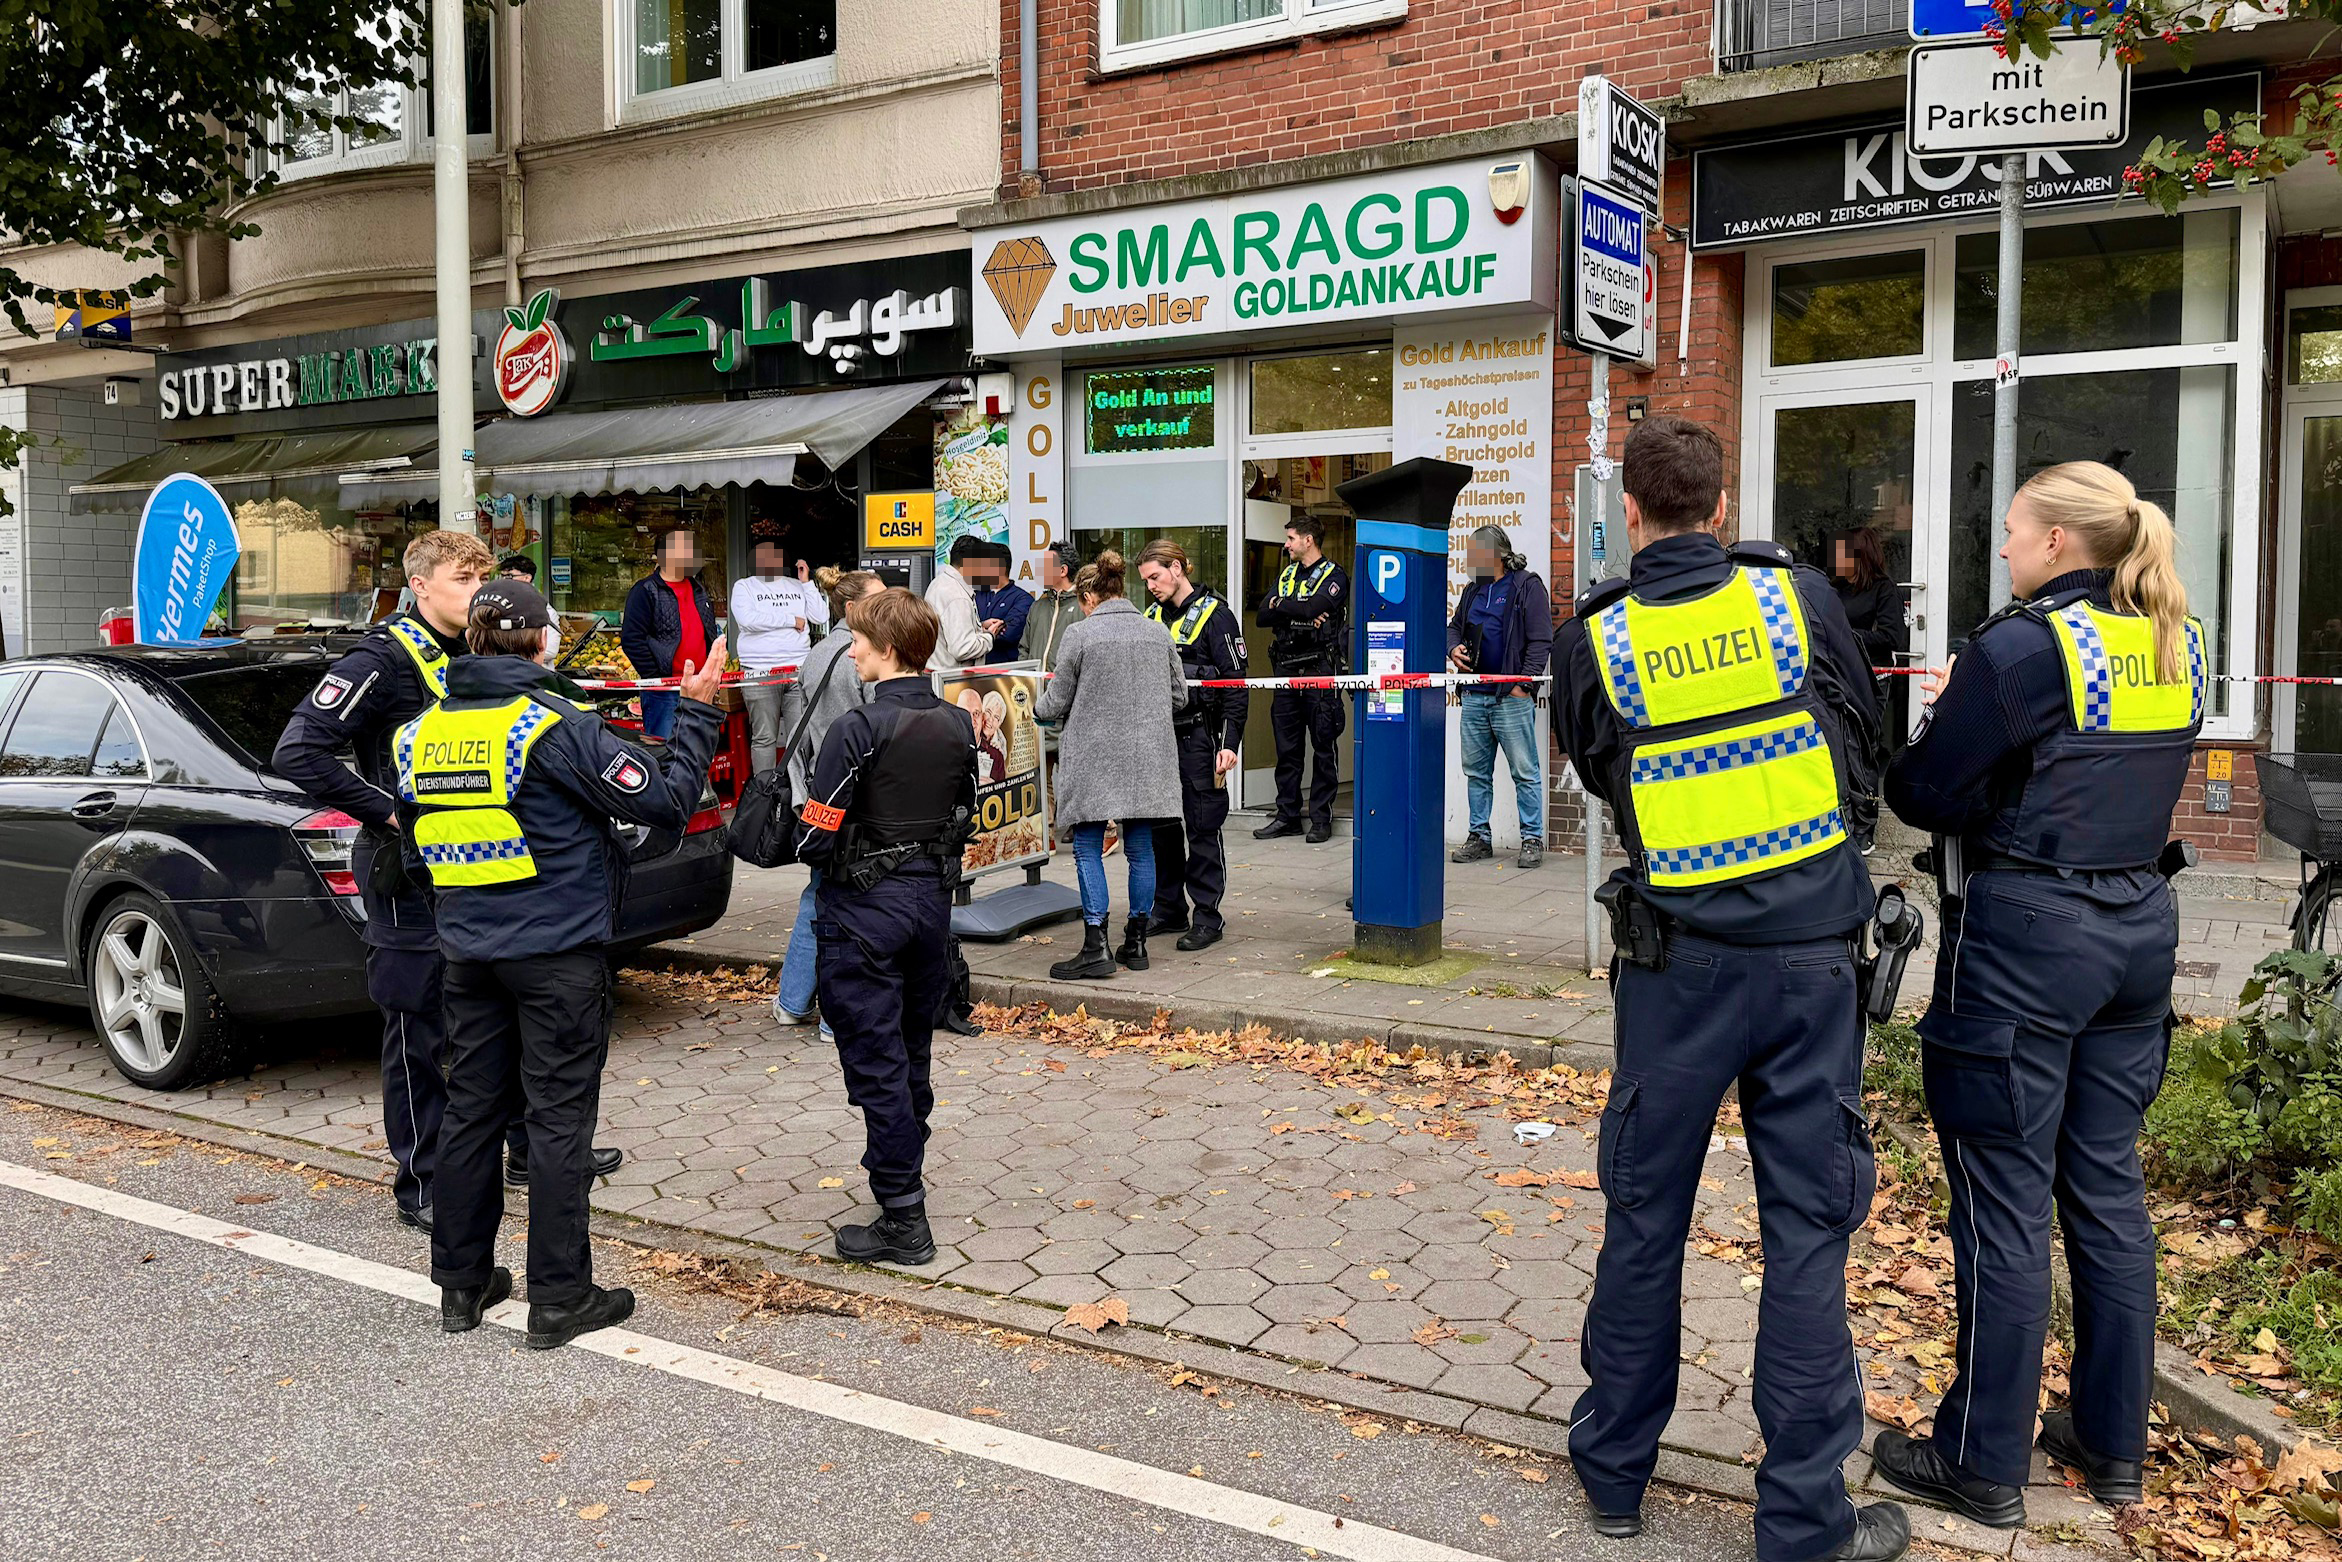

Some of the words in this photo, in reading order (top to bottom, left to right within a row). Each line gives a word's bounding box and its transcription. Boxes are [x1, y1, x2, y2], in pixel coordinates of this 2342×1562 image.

[1992, 63, 2043, 91] mit
[1928, 95, 2107, 131] Parkschein
[1612, 100, 1658, 172] KIOSK
[1583, 203, 1640, 256] AUTOMAT
[1724, 211, 1821, 235] TABAKWAREN
[1829, 198, 1929, 223] ZEITSCHRIFTEN
[1069, 185, 1469, 293] SMARAGD
[1233, 253, 1497, 319] GOLDANKAUF
[1582, 252, 1640, 293] Parkschein
[1052, 293, 1208, 336] Juwelier
[1585, 283, 1605, 312] hier
[1609, 290, 1636, 320] lösen
[1400, 341, 1454, 366] Gold
[1459, 332, 1547, 361] Ankauf
[106, 386, 116, 400] 74
[1402, 379, 1417, 390] zu
[1420, 369, 1540, 390] Tageshöchstpreisen
[1095, 389, 1137, 410] Gold
[1142, 388, 1168, 407] An
[1174, 385, 1212, 405] und
[1445, 397, 1510, 420] Altgold
[1114, 416, 1191, 439] verkauf
[1446, 419, 1528, 441] Zahngold
[945, 431, 988, 457] Hoşgeldiniz
[1446, 441, 1536, 463] Bruchgold
[880, 521, 922, 538] CASH
[156, 500, 204, 641] Hermes
[192, 538, 217, 609] PaketShop
[1379, 555, 1401, 593] P
[757, 593, 801, 602] BALMAIN
[1644, 626, 1762, 683] POLIZEI
[325, 676, 350, 690] POLIZEI
[422, 740, 491, 766] POLIZEI
[606, 754, 627, 780] POLIZEI
[417, 773, 489, 791] DIENSTHUNDFÜHRER
